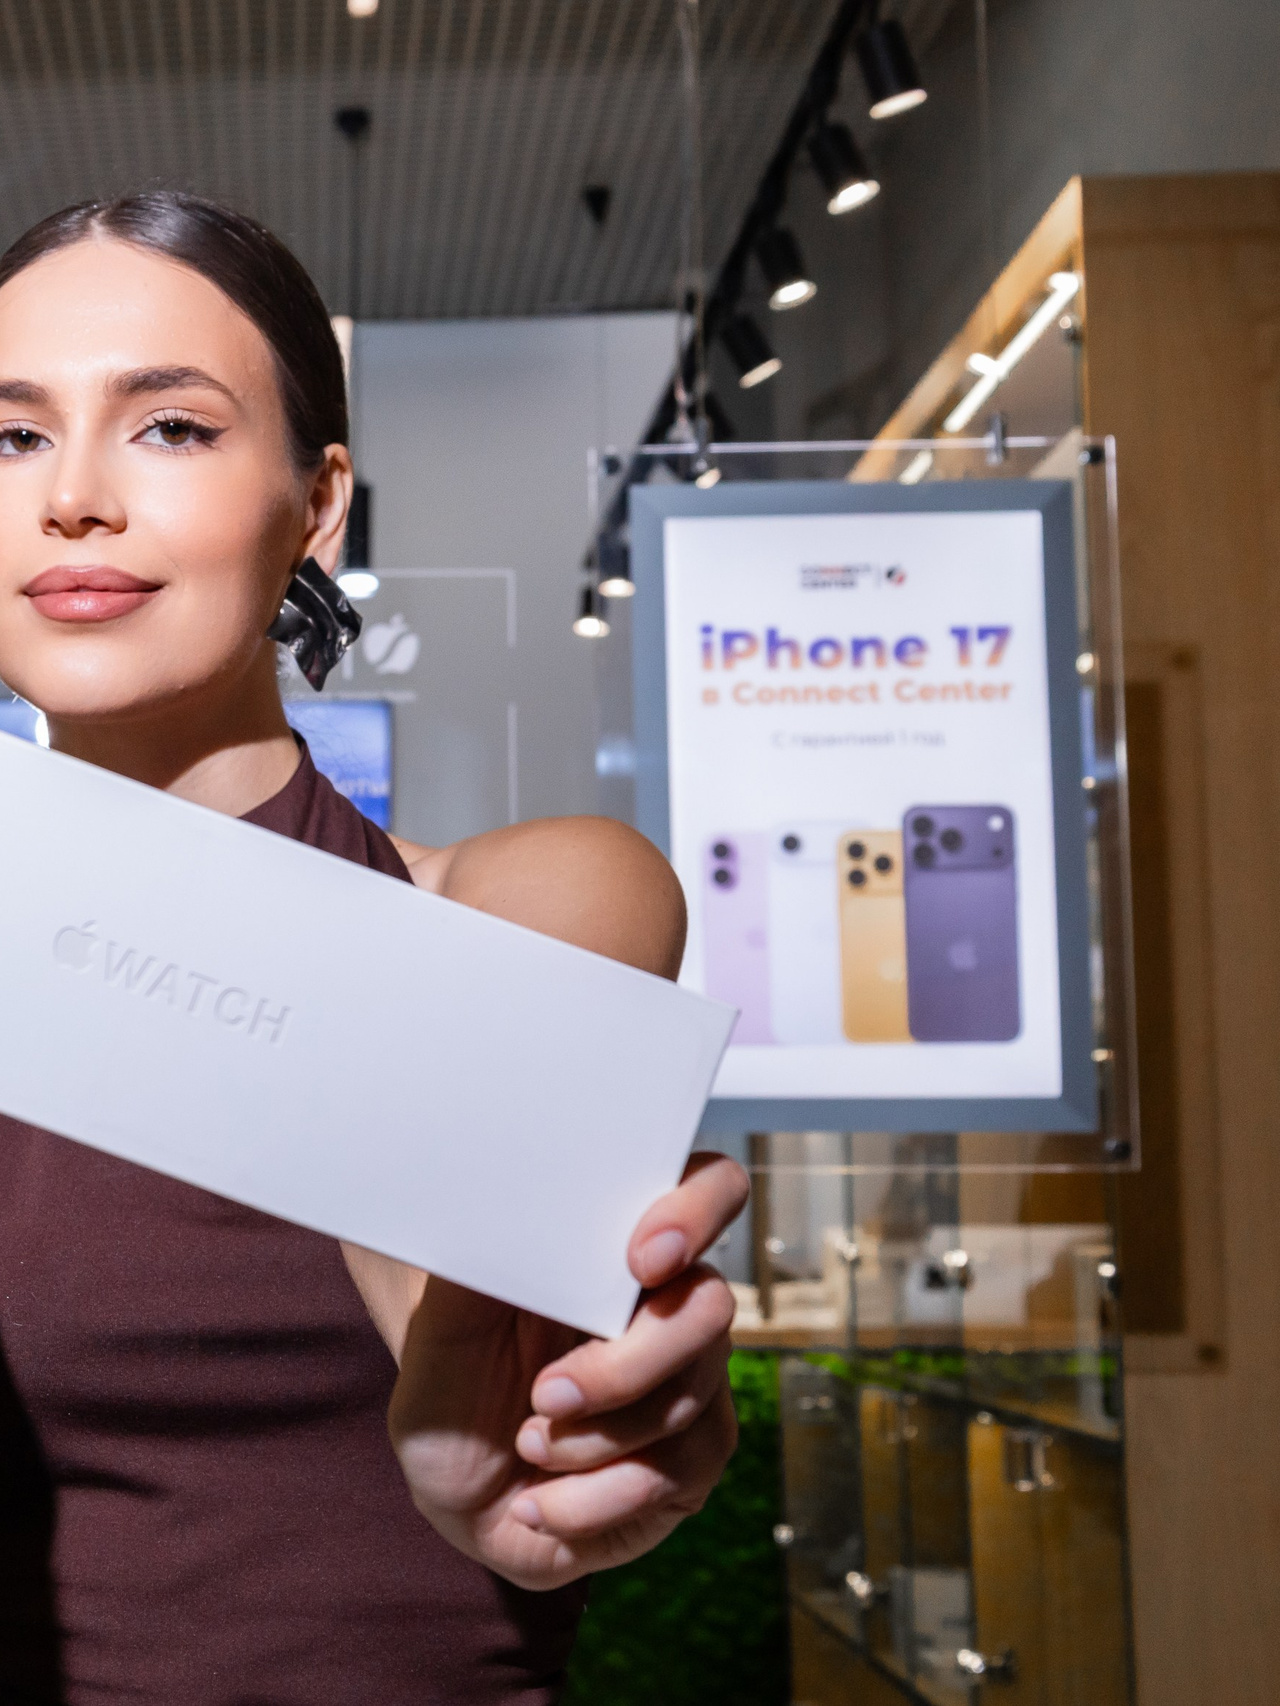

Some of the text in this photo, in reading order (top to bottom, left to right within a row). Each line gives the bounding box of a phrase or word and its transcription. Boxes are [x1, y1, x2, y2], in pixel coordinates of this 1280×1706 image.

[701, 623, 1014, 670] iPhone 17
[732, 680, 880, 705] Connect
[893, 678, 1013, 703] Center
[104, 939, 293, 1047] WATCH
